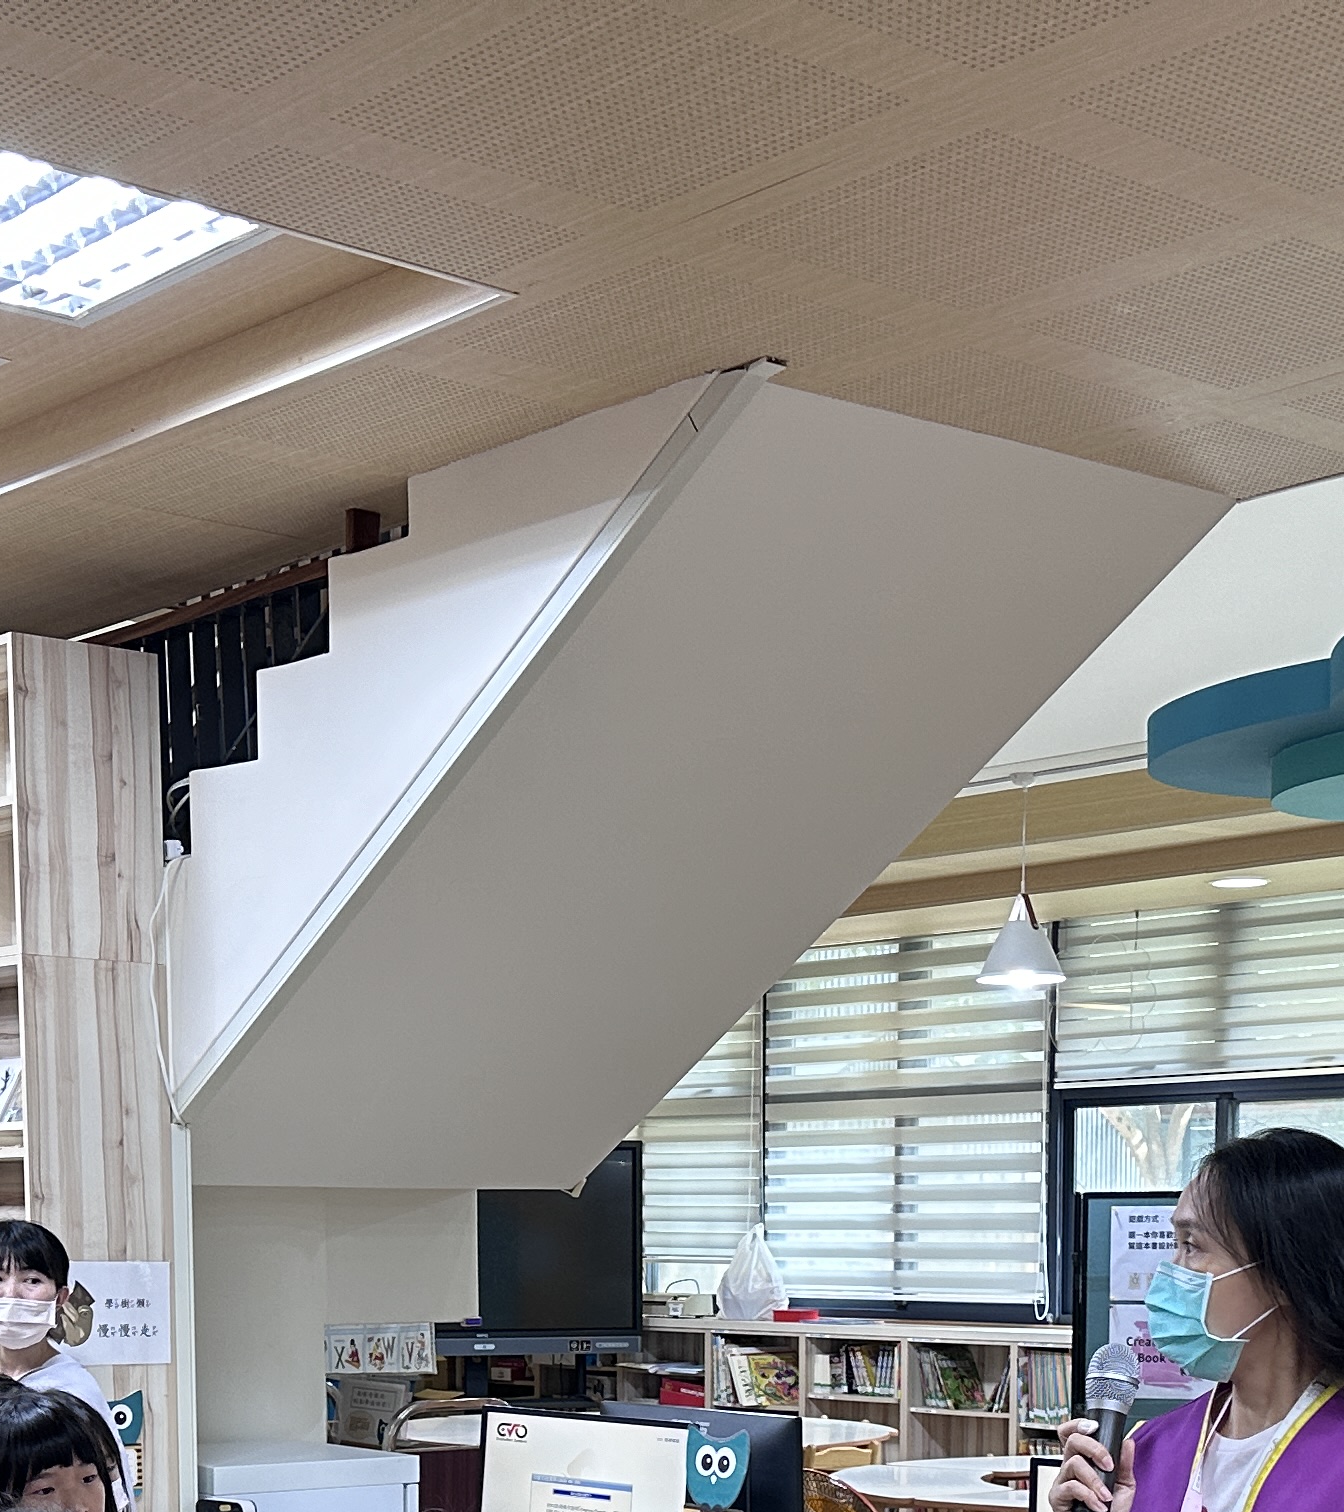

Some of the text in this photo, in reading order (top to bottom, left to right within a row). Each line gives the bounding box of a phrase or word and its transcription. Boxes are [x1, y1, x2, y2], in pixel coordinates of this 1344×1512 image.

[97, 1323, 158, 1339] 慢慢走
[1137, 1353, 1167, 1364] Book
